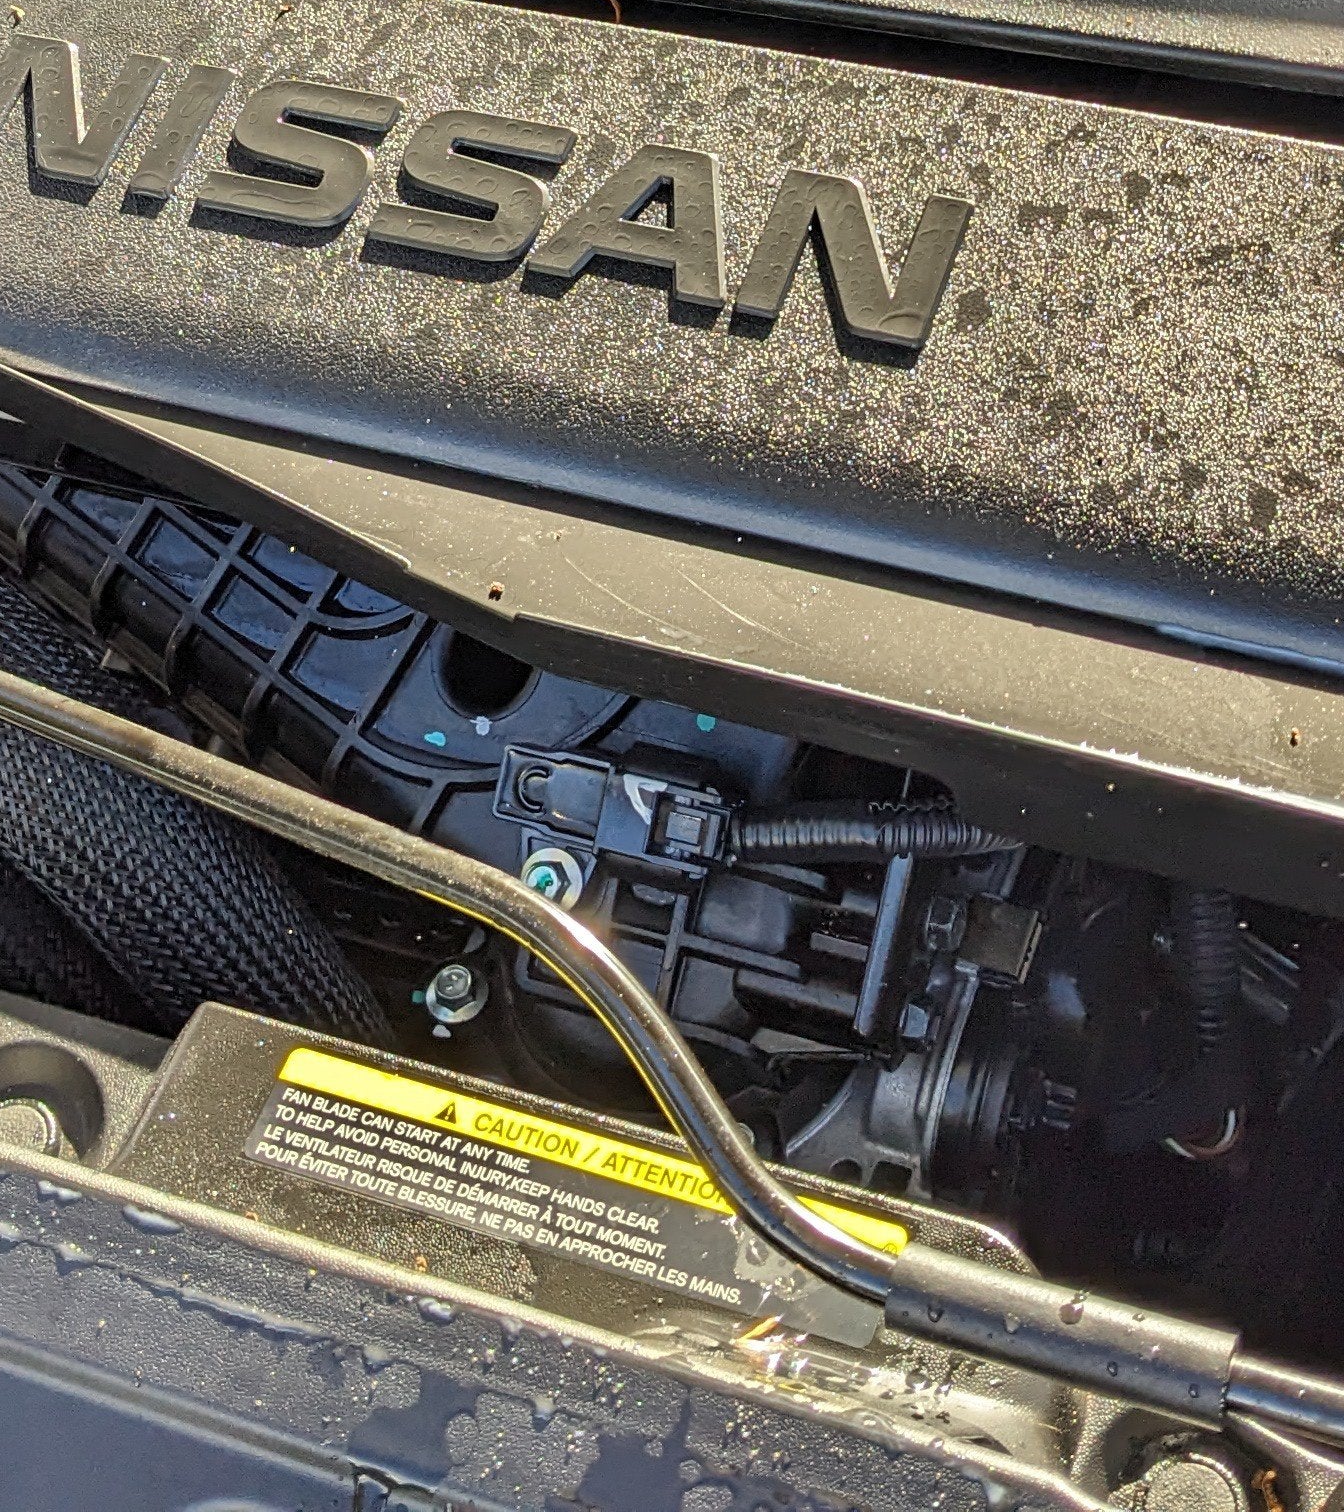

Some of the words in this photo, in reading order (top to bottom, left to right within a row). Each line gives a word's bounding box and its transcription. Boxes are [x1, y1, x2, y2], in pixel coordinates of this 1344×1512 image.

[263, 1123, 285, 1141] LE
[285, 1129, 376, 1169] VENTILATEUR
[376, 1158, 434, 1187] RISQUE
[433, 1175, 457, 1194] DE
[456, 1182, 540, 1220] DÉMARRER
[539, 1205, 553, 1224] À
[555, 1212, 597, 1236] TOUT
[595, 1225, 667, 1260] MOMENT.
[275, 1104, 295, 1121] TO
[295, 1111, 335, 1132] HELP
[333, 1123, 379, 1146] AVOID
[380, 1136, 456, 1172] PERSONAL
[550, 1188, 606, 1216] HANDS
[606, 1206, 659, 1234] CLEAR.
[282, 1087, 312, 1107] FAN
[311, 1096, 361, 1121] BLADE
[361, 1111, 394, 1131] CAN
[395, 1121, 441, 1145] START
[439, 1136, 461, 1151] AT
[459, 1142, 494, 1161] ANY
[495, 1150, 530, 1173] TIME.
[474, 1113, 579, 1158] CAUTION
[583, 1147, 600, 1162] /
[600, 1152, 723, 1203] ATTENTIO
[254, 1141, 298, 1166] POUR
[297, 1151, 349, 1181] ÉVITER
[349, 1169, 398, 1196] TOUTE
[396, 1185, 477, 1224] BLESSURE,
[479, 1210, 504, 1229] NE
[502, 1217, 535, 1239] PAS
[535, 1227, 559, 1246] EN
[558, 1236, 657, 1277] APPROCHER
[656, 1265, 688, 1287] LES
[688, 1275, 741, 1305] MAINS.
